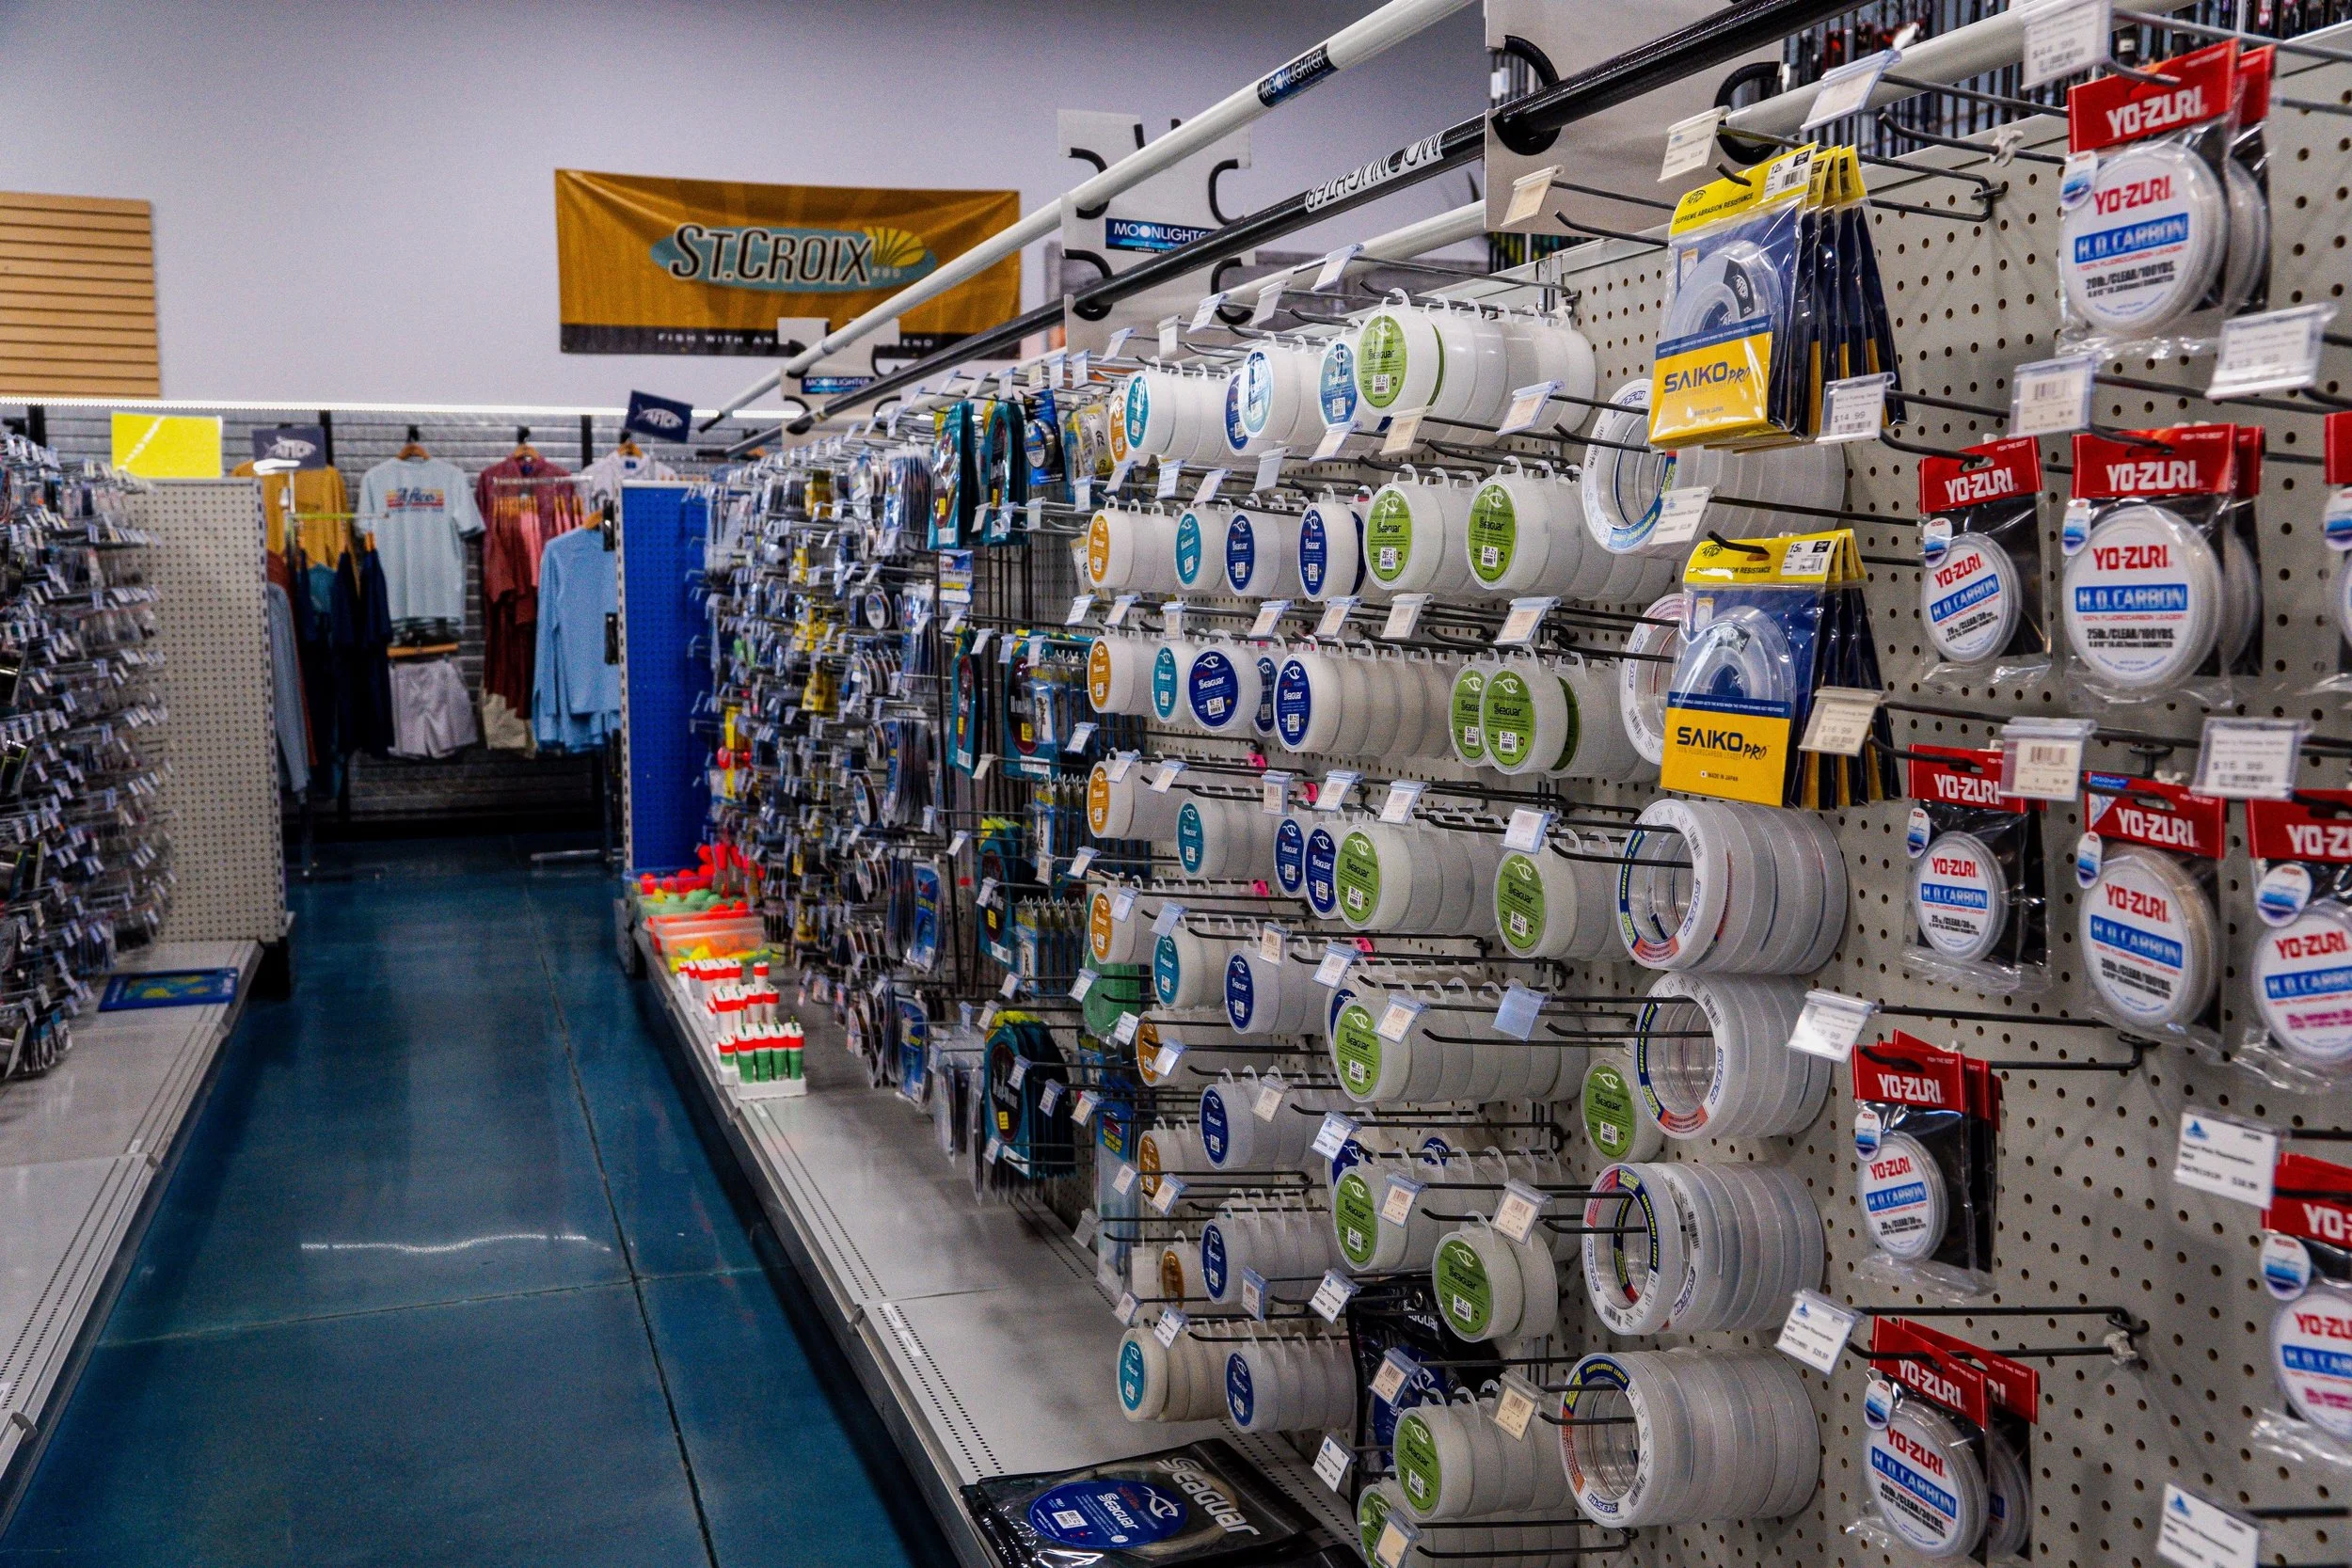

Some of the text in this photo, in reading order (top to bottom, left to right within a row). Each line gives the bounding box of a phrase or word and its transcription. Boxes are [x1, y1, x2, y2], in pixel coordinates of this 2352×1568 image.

[1259, 50, 1326, 99] MOONLIGHTER
[2106, 86, 2203, 138] YO-ZURI
[1306, 132, 1444, 213] MOONLIGHTER
[1675, 192, 1755, 225] SUPREME ABRASION RESISTANCE
[2094, 175, 2171, 216] YO-ZURI
[1114, 222, 1213, 242] MOONLIGHTE
[659, 332, 773, 345] FISH WITH AN
[1664, 361, 1729, 393] SAIKO
[1945, 467, 2015, 504] YO-ZURI
[2106, 460, 2197, 492] YO-ZURI
[1376, 521, 1401, 533] Seaguar
[1478, 515, 1505, 532] Seaguar
[1739, 565, 1772, 574] RESISTANCE
[1934, 553, 1983, 589] YO-ZURI
[2093, 545, 2169, 571] YO-ZURI
[1199, 677, 1225, 689] Seaguar
[1493, 703, 1522, 717] Seaguar
[1677, 726, 1768, 761] SAIKO PRO
[1933, 774, 2000, 805] YO-ZURI
[2117, 807, 2195, 848] YO-ZURI
[1345, 857, 1370, 879] Seaguar
[1931, 857, 1977, 879] YO-ZURI
[1507, 881, 1534, 904] Seaguar
[2106, 883, 2169, 923] YO-ZURI
[2275, 931, 2348, 959] YO-ZURI
[1345, 1031, 1370, 1051] Seaguar
[1595, 1092, 1622, 1112] Seaguar
[1877, 1073, 1942, 1104] YO-ZURI
[1869, 1156, 1912, 1180] YO-ZURI
[1345, 1199, 1367, 1220] Seaguar
[1449, 1265, 1478, 1291] Seaguar
[1899, 1359, 1963, 1408] YO-ZURI
[1886, 1425, 1945, 1477] YO-ZURI
[1097, 1492, 1141, 1530] Seaguar
[1155, 1457, 1261, 1537] Seaguar
[1587, 1493, 1619, 1513] HI-SEAS
